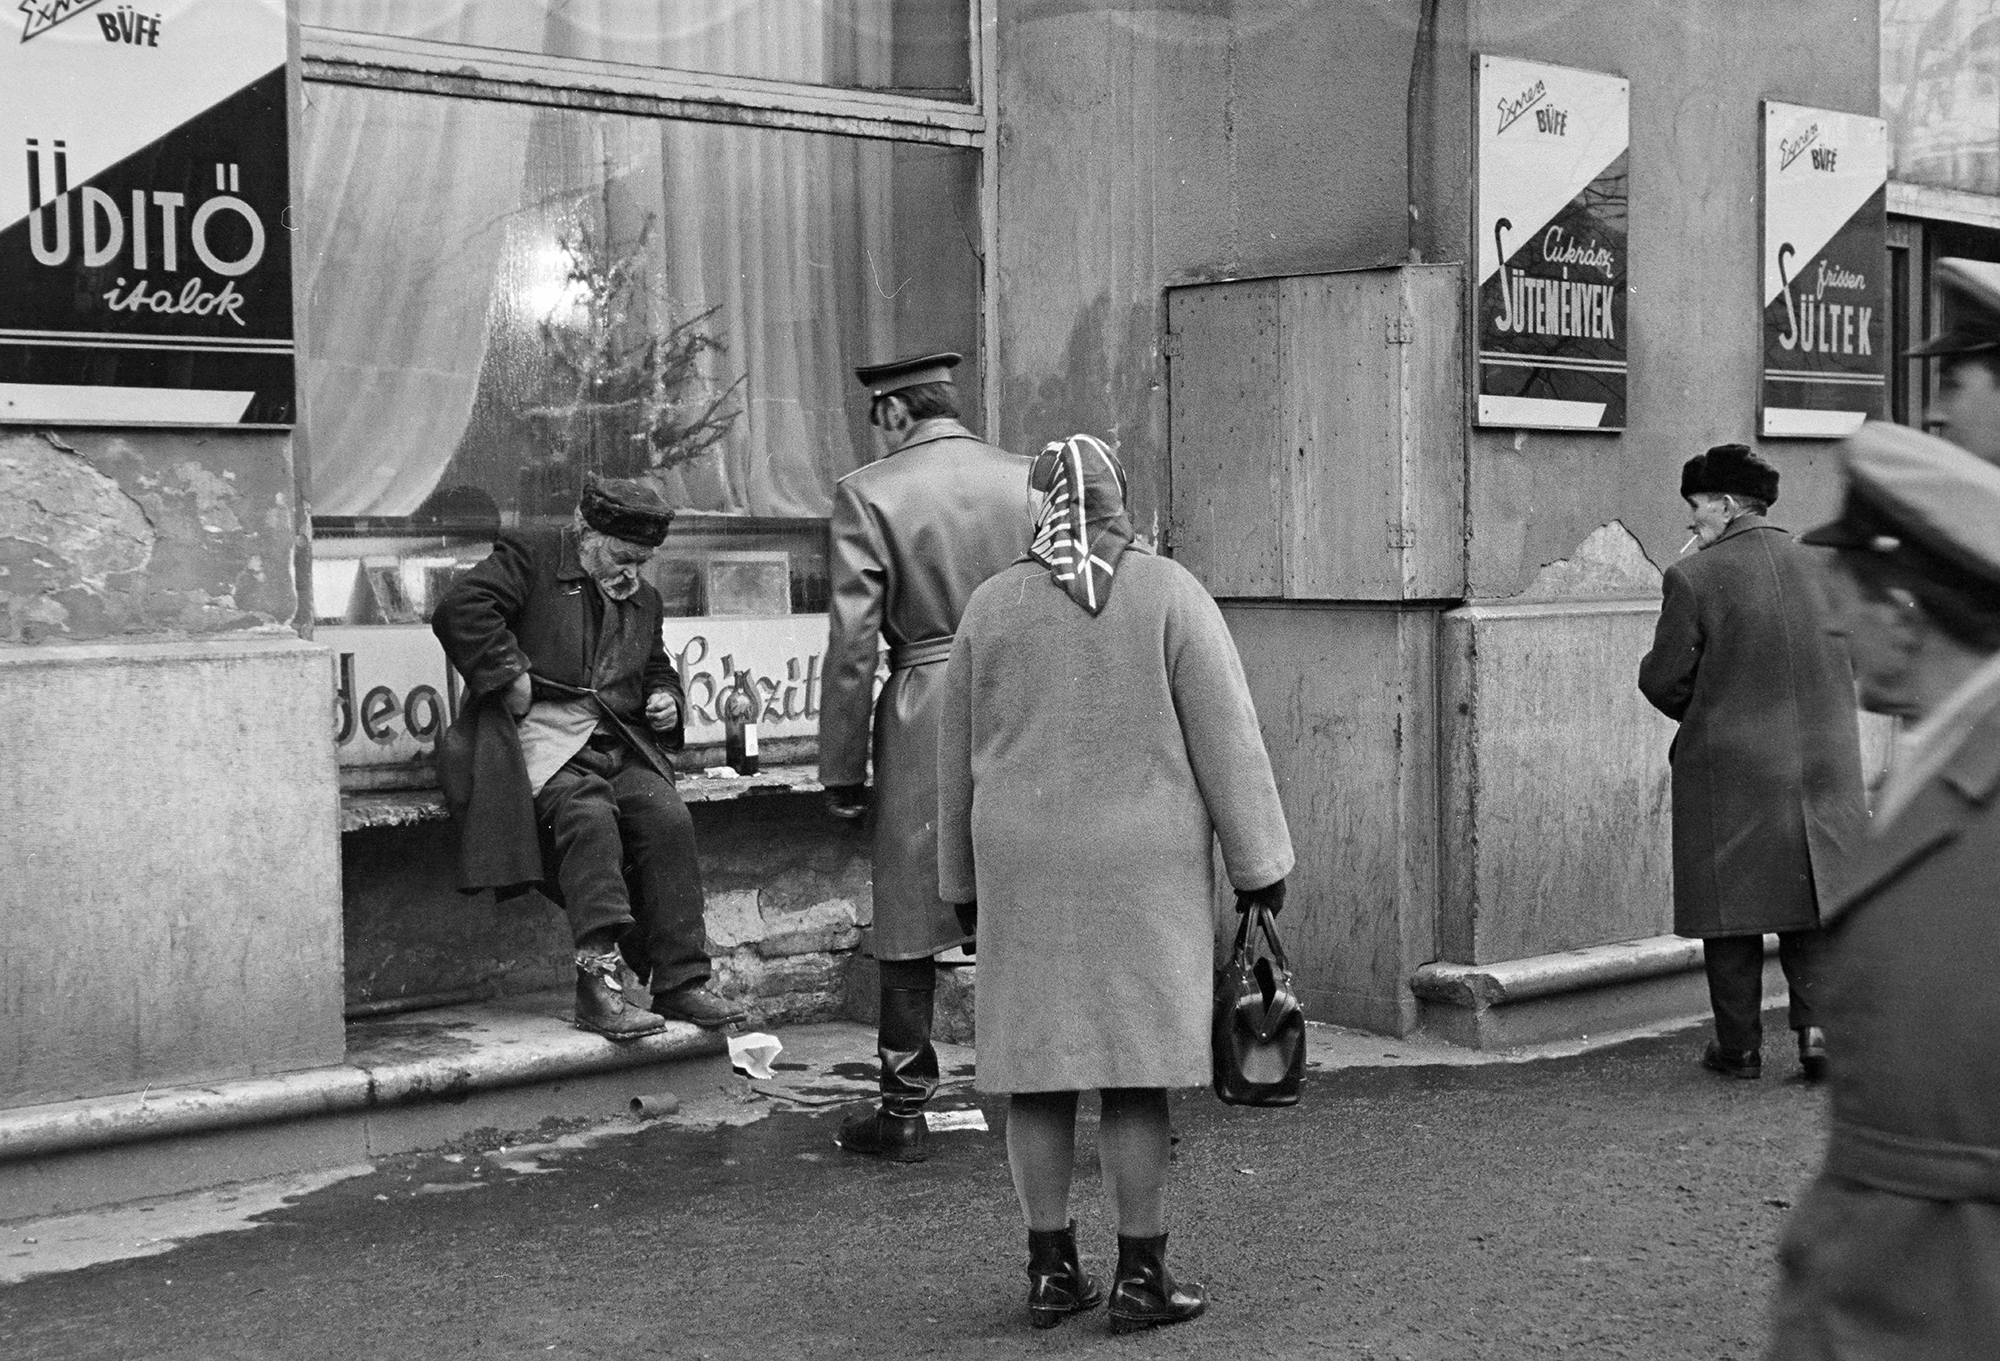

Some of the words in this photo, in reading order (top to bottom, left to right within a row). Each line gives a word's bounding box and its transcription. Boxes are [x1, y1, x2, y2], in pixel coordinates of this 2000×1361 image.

[96, 5, 162, 48] BÜFÉ
[1535, 103, 1568, 137] BÜFÉ
[1811, 143, 1838, 173] BÜFÉ
[102, 276, 246, 327] italok
[1494, 217, 1615, 340] SÜTEMÉNYEK
[1778, 241, 1873, 356] SÜLTEK
[1816, 259, 1866, 301] Frissen
[335, 652, 460, 746] deal
